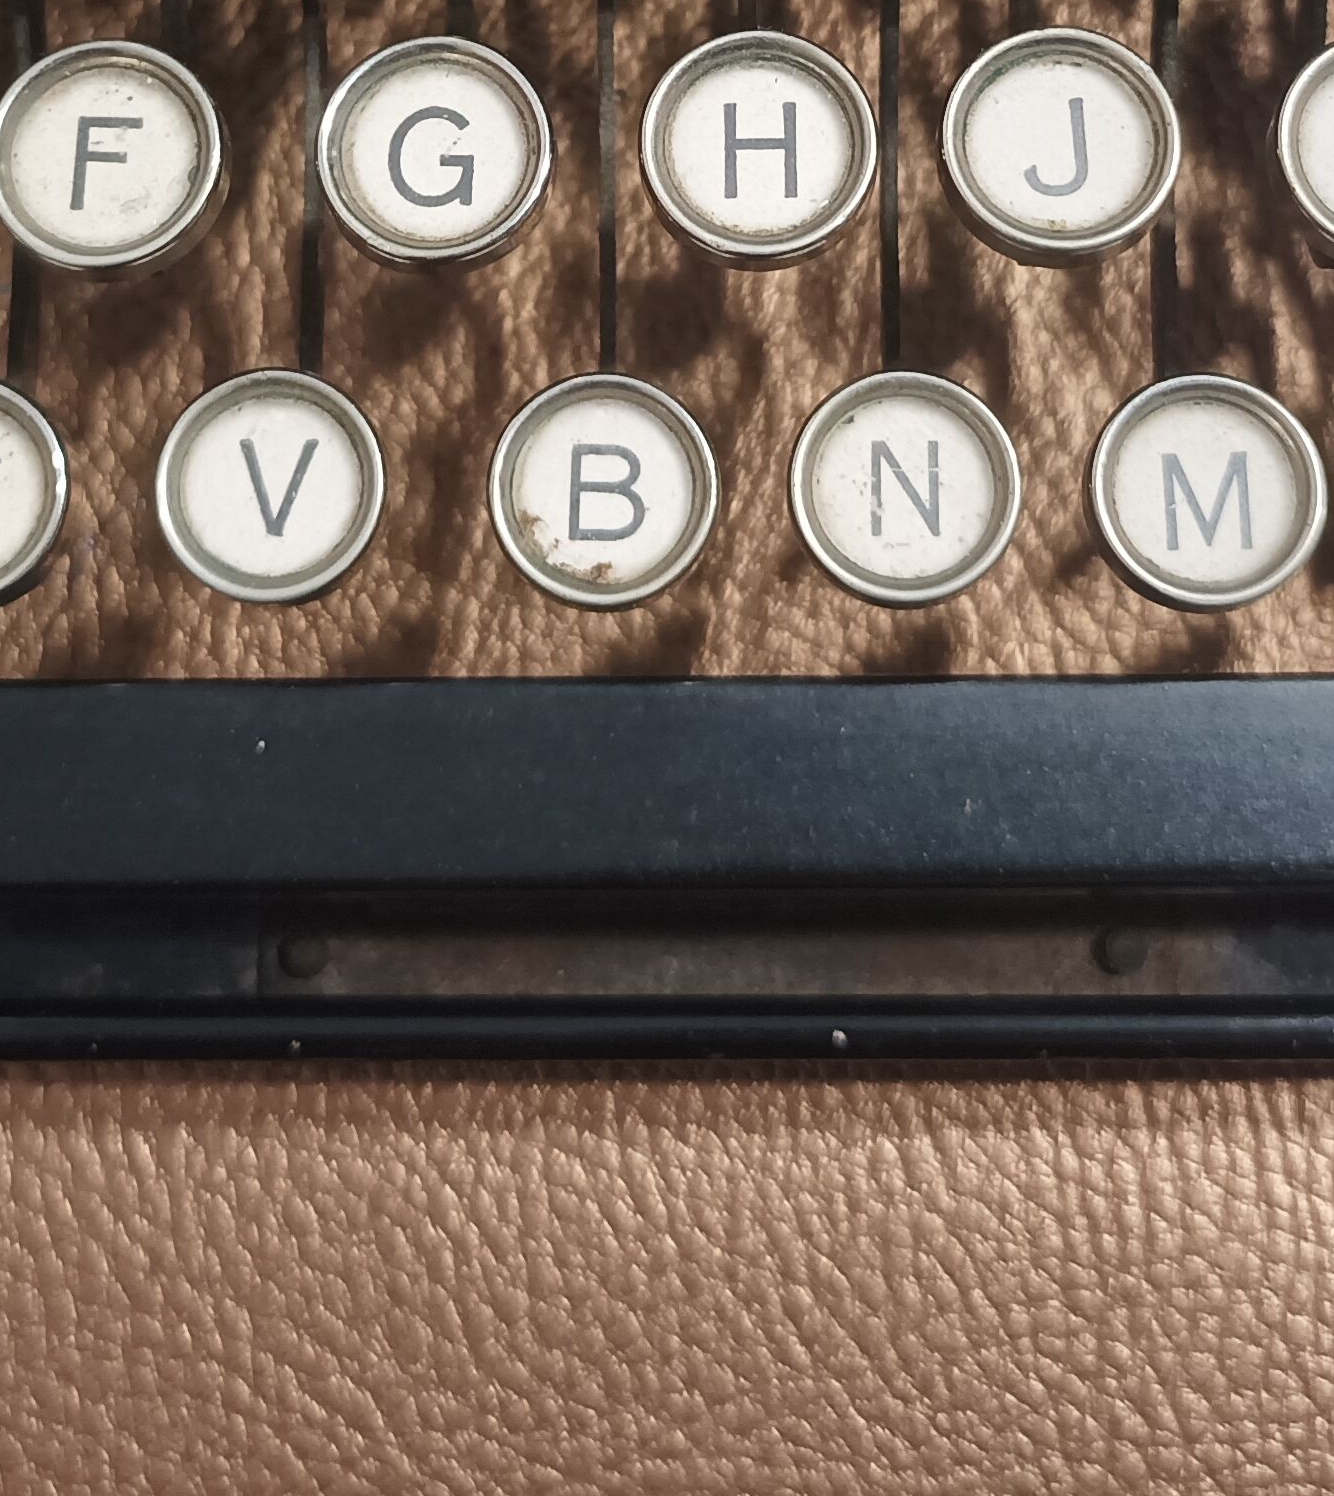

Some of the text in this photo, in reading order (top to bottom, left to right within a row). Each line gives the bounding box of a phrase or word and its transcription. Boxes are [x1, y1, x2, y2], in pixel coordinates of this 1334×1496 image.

[69, 115, 143, 211] F
[387, 105, 475, 208] G
[723, 102, 797, 199] H
[1024, 97, 1088, 197] J
[239, 438, 320, 537] V
[568, 443, 645, 541] B
[870, 439, 941, 537] N
[1161, 450, 1253, 551] M
